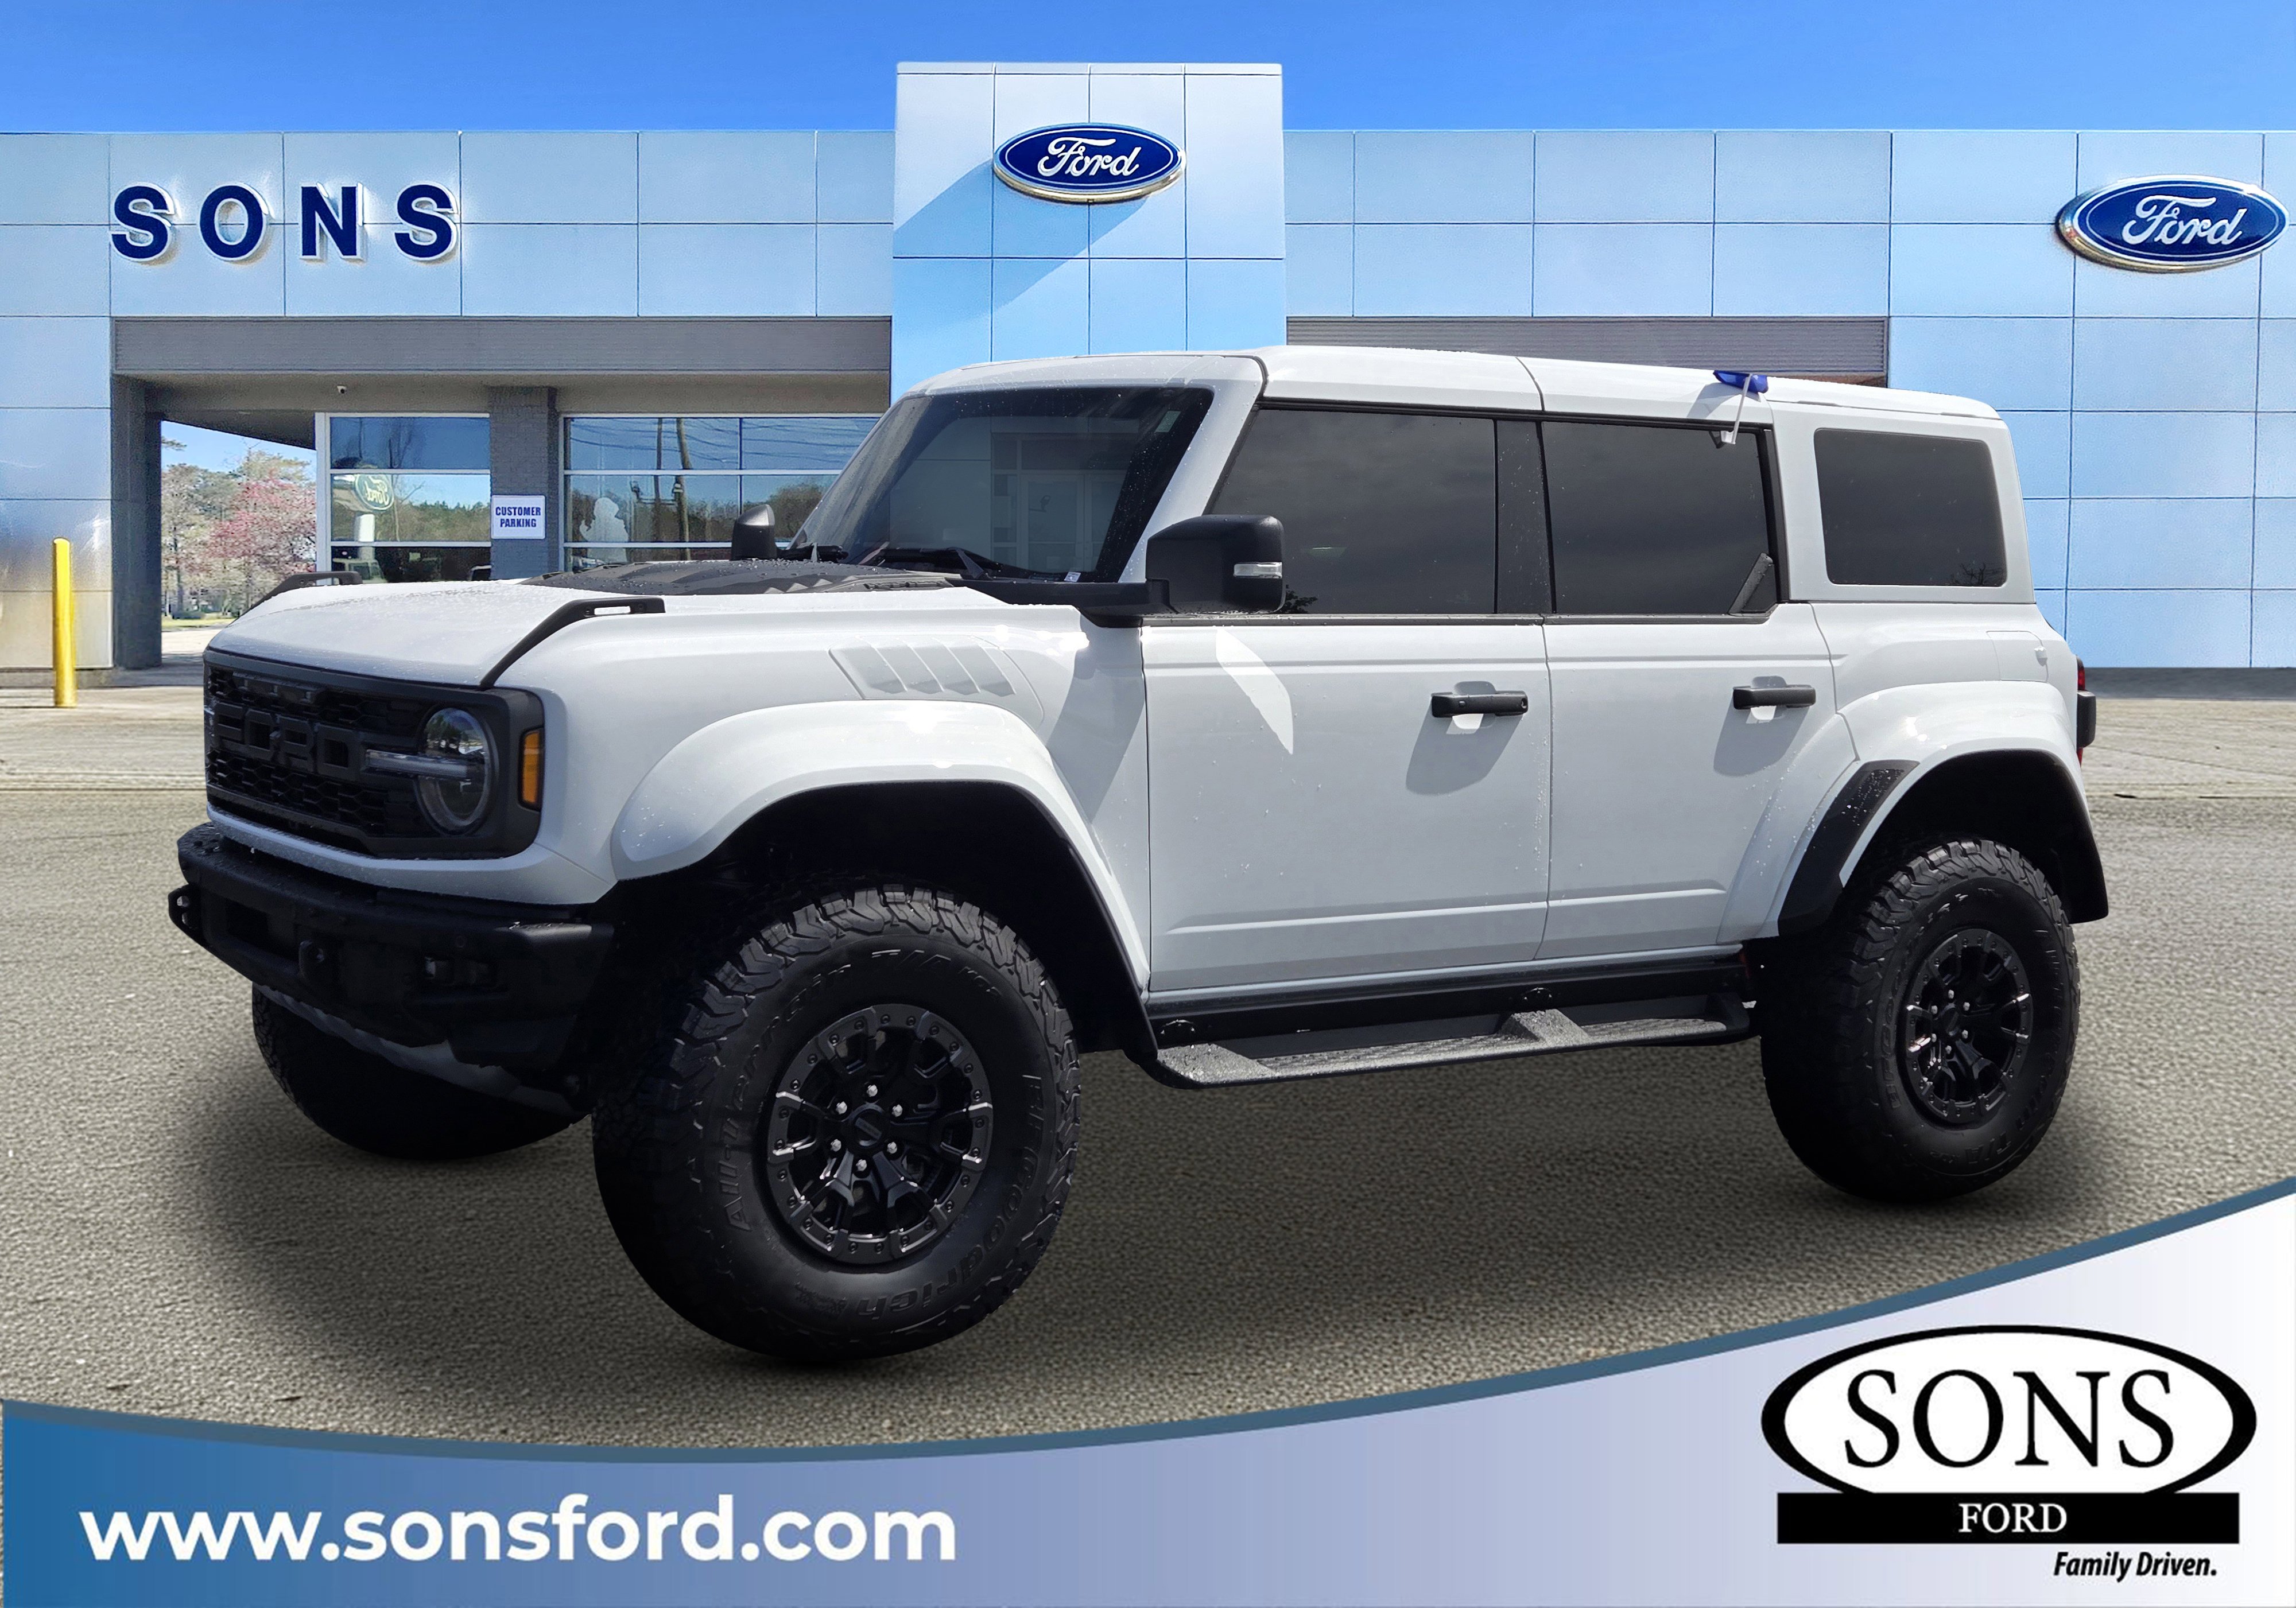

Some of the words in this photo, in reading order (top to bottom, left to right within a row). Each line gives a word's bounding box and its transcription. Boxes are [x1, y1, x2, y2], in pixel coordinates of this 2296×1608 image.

[1037, 137, 1142, 177] Ford
[111, 182, 458, 262] SONS
[2122, 195, 2247, 245] Ford
[495, 506, 541, 516] CUSTOMER
[500, 518, 537, 527] PARKING
